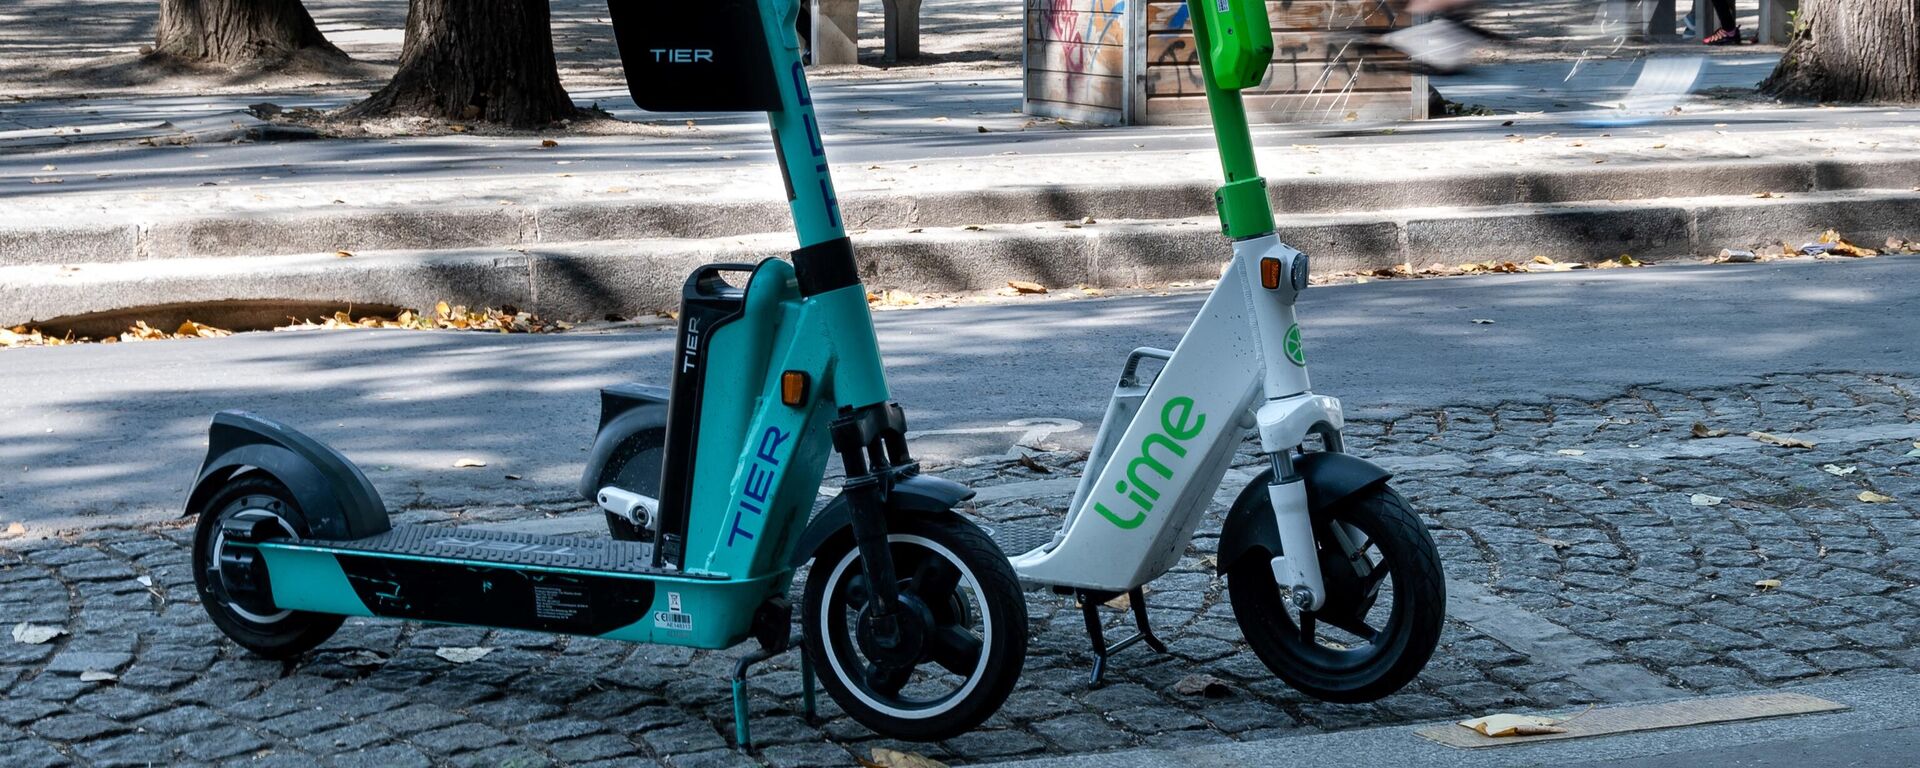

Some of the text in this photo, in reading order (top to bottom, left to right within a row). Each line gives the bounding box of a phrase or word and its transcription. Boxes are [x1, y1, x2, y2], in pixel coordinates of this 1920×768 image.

[650, 48, 714, 63] TIER
[683, 316, 701, 374] TIER
[727, 425, 790, 547] TIER
